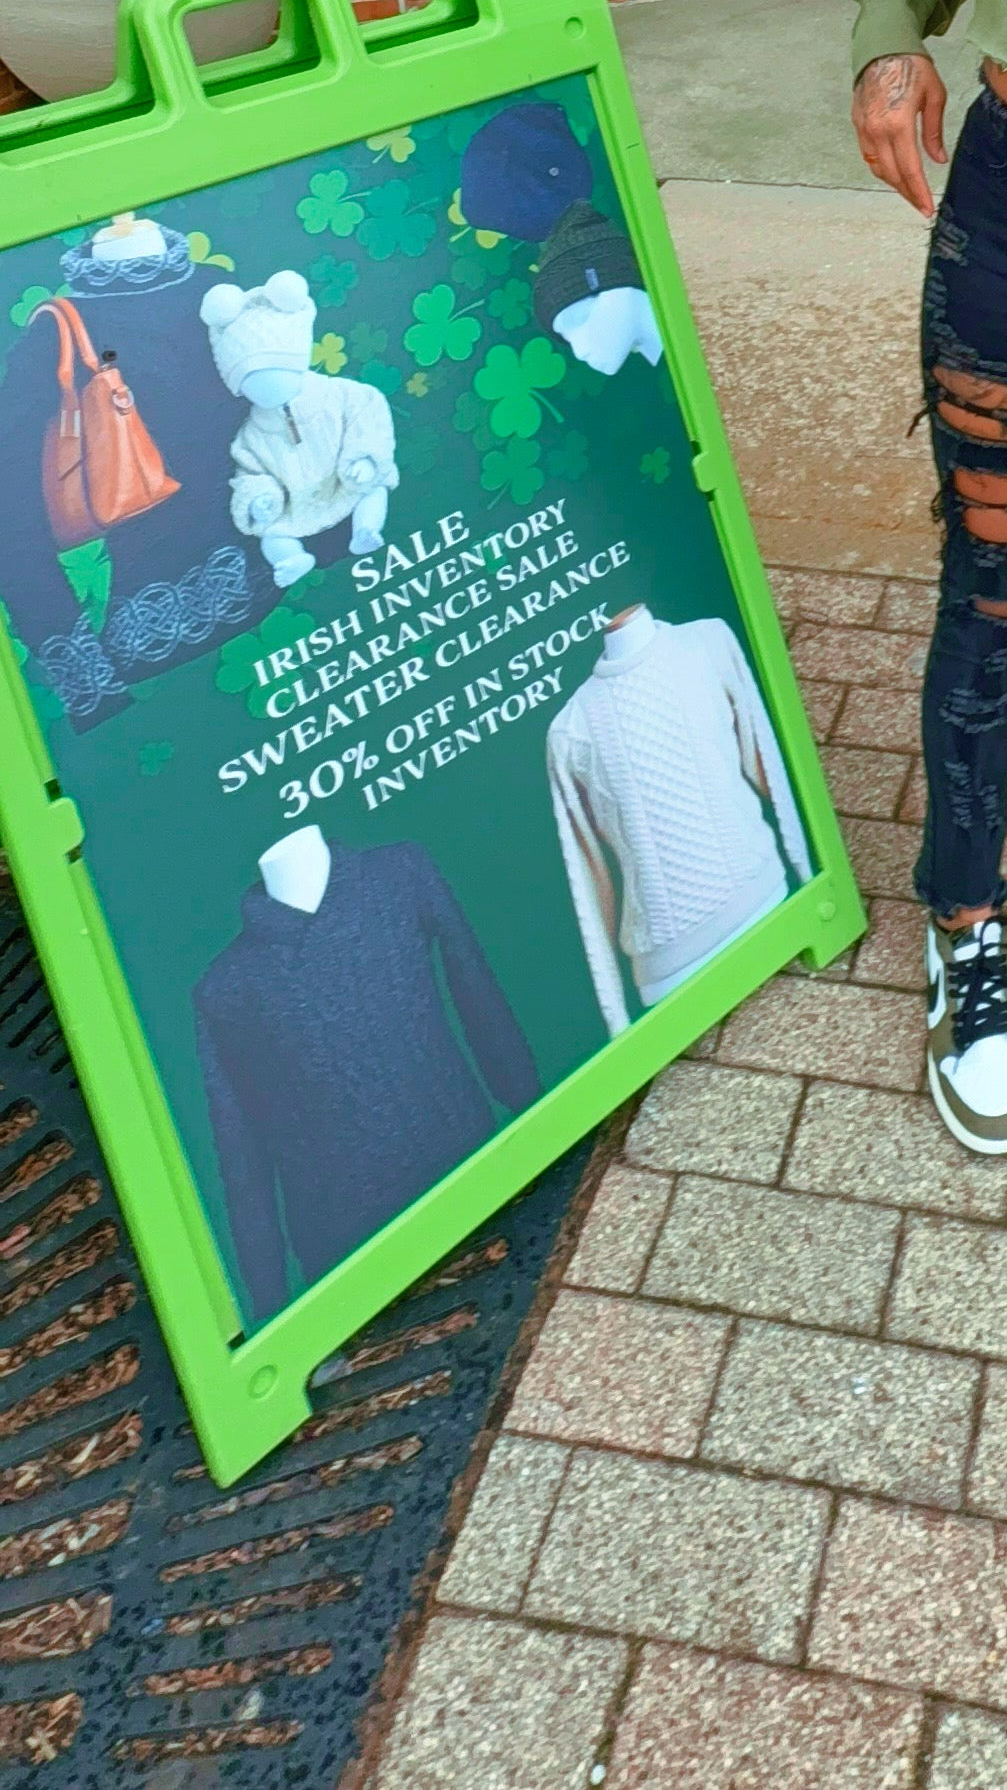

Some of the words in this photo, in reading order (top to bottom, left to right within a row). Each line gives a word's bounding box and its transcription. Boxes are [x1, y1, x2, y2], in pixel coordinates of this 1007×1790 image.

[253, 609, 363, 687] IRISH
[370, 498, 567, 625] INVENTORY
[265, 578, 493, 719] CLEARANCE
[495, 530, 580, 593] SALE
[350, 510, 470, 593] SALE
[218, 656, 430, 793] SWEATER
[435, 540, 631, 669] CLEARANCE
[278, 740, 380, 819] 30%
[385, 695, 457, 755] OFF
[463, 667, 504, 709] IN
[507, 602, 611, 681] STOCK
[362, 666, 565, 811] INVENTORY
